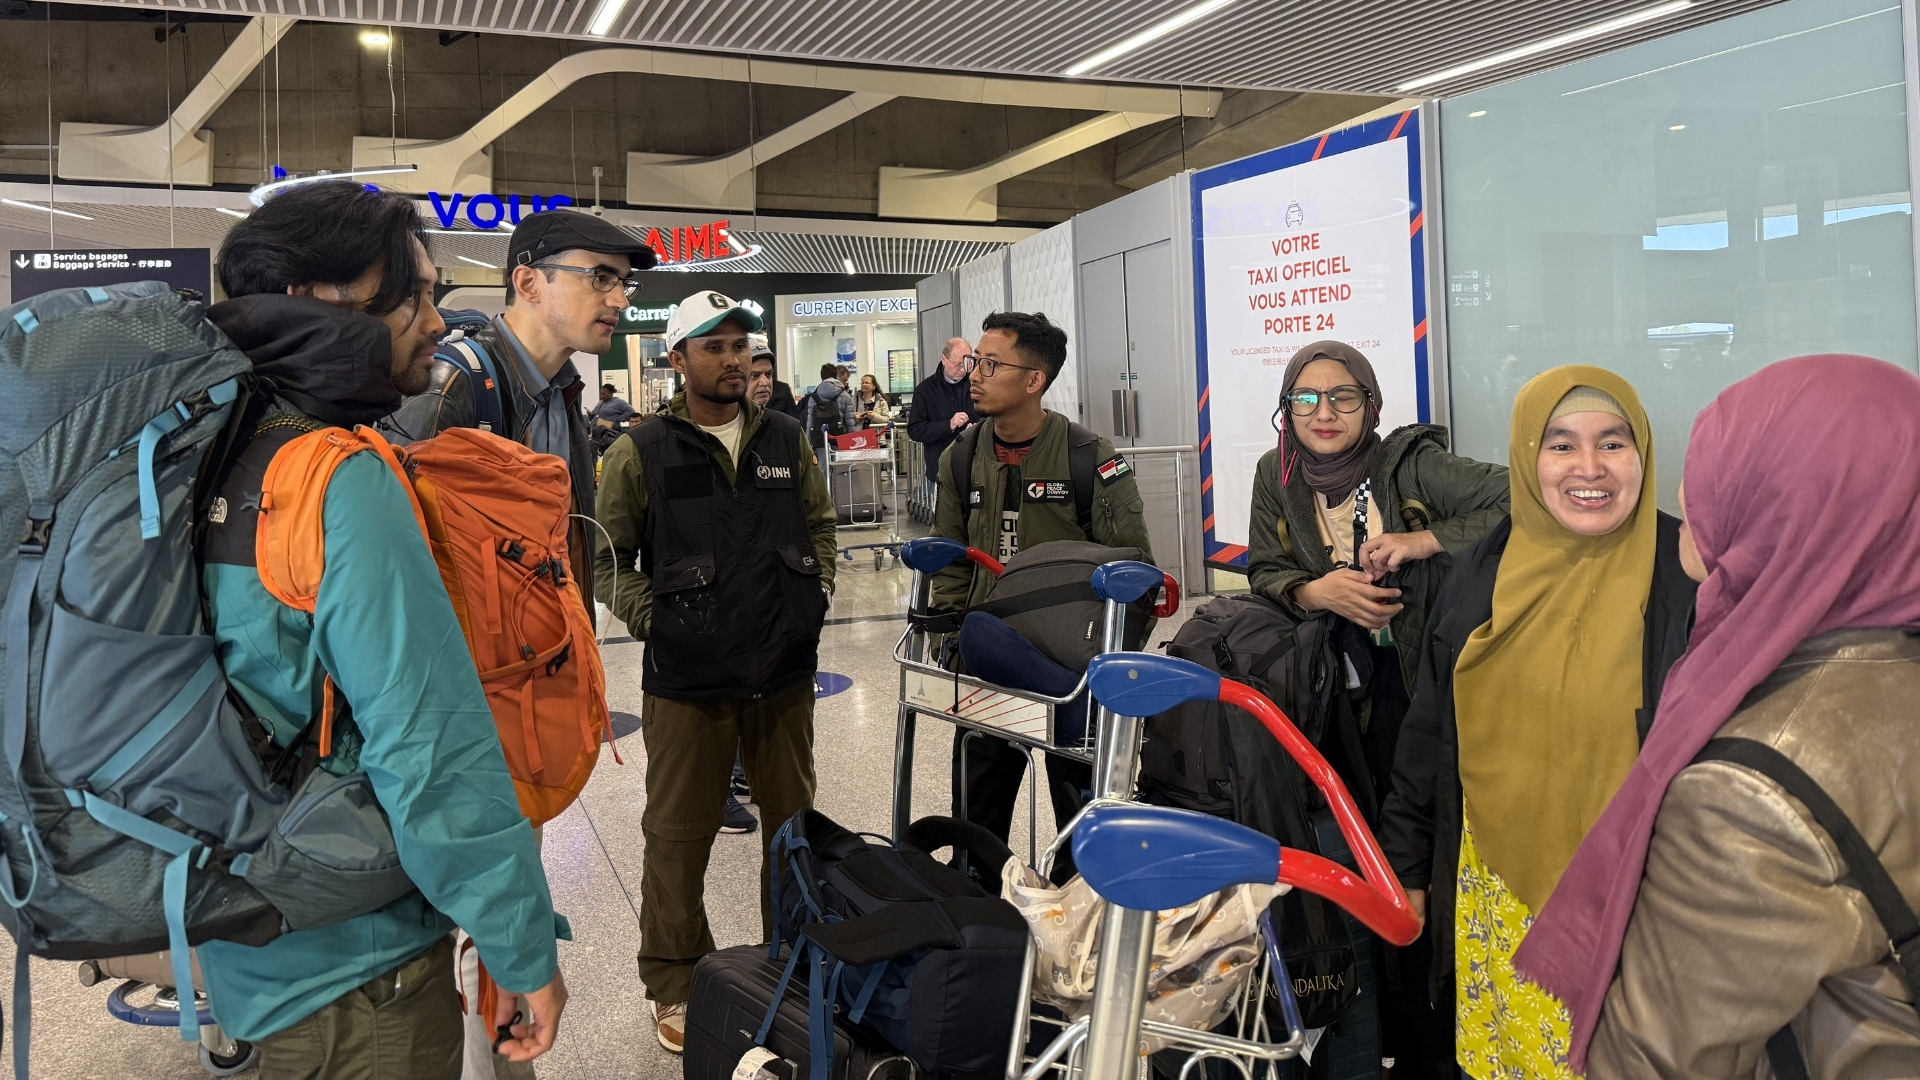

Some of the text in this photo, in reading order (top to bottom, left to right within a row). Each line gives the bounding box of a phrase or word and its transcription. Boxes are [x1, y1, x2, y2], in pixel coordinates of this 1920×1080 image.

[645, 219, 731, 263] AIME
[1271, 232, 1321, 256] VOTRE
[53, 253, 128, 262] Service bagages
[53, 261, 95, 270] Baggage
[1247, 255, 1351, 285] TAXI OFFICIEL
[707, 293, 729, 310] G
[1248, 283, 1352, 311] VOUS ATTEND
[793, 300, 875, 316] CURRENCY
[1264, 312, 1335, 335] PORTE 24
[1230, 348, 1245, 356] YOUR
[1245, 346, 1271, 355] LICENSED
[1272, 346, 1284, 354] TAXI
[1285, 345, 1291, 353] IS
[1356, 340, 1370, 349] EXIT
[1372, 339, 1381, 348] 24
[772, 467, 791, 478] INH
[1265, 973, 1345, 1000] MNDALIKA
